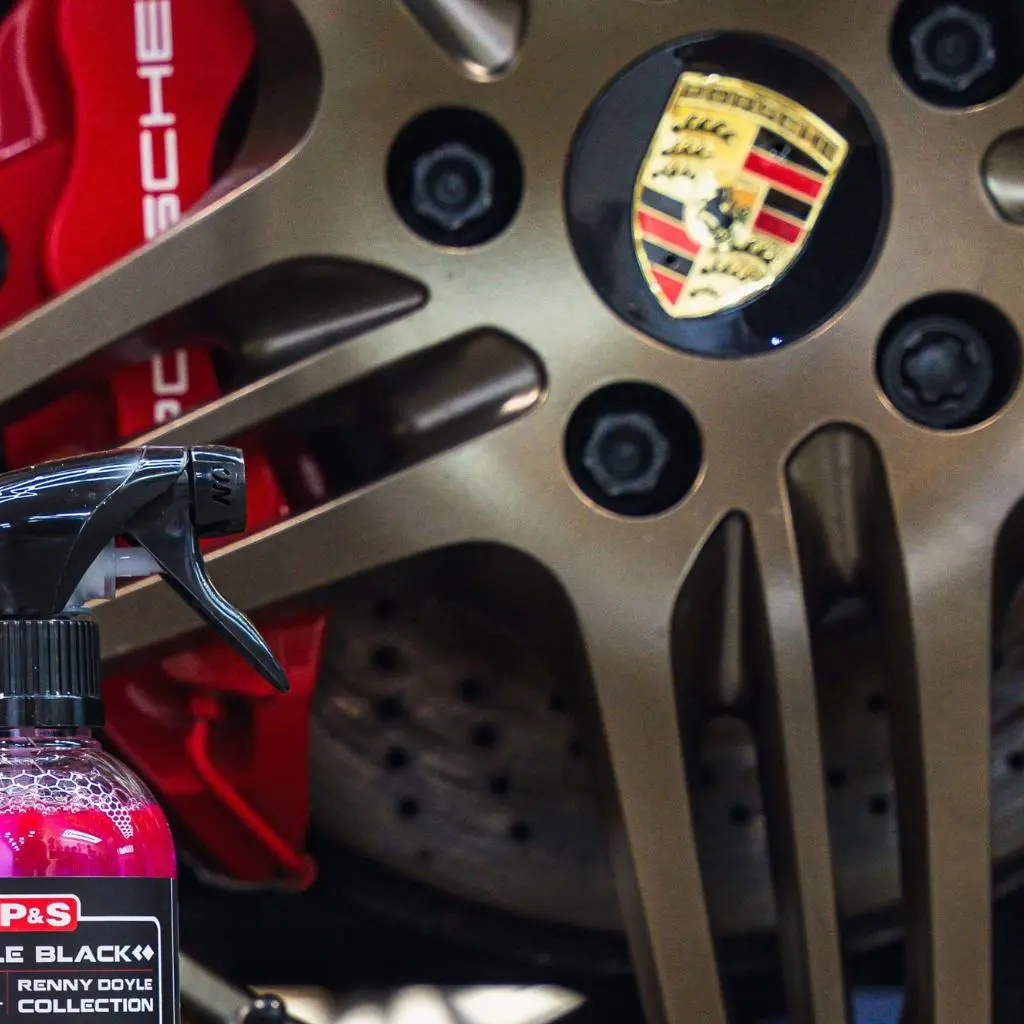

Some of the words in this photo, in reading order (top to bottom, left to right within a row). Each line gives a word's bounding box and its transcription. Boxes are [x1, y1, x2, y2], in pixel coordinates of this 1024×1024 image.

[133, 0, 190, 424] OSCHE
[0, 902, 71, 927] P&S
[35, 945, 132, 963] BLACK
[17, 979, 93, 992] RENNY
[97, 978, 153, 991] DOYLE
[17, 998, 154, 1013] COLLECTION
